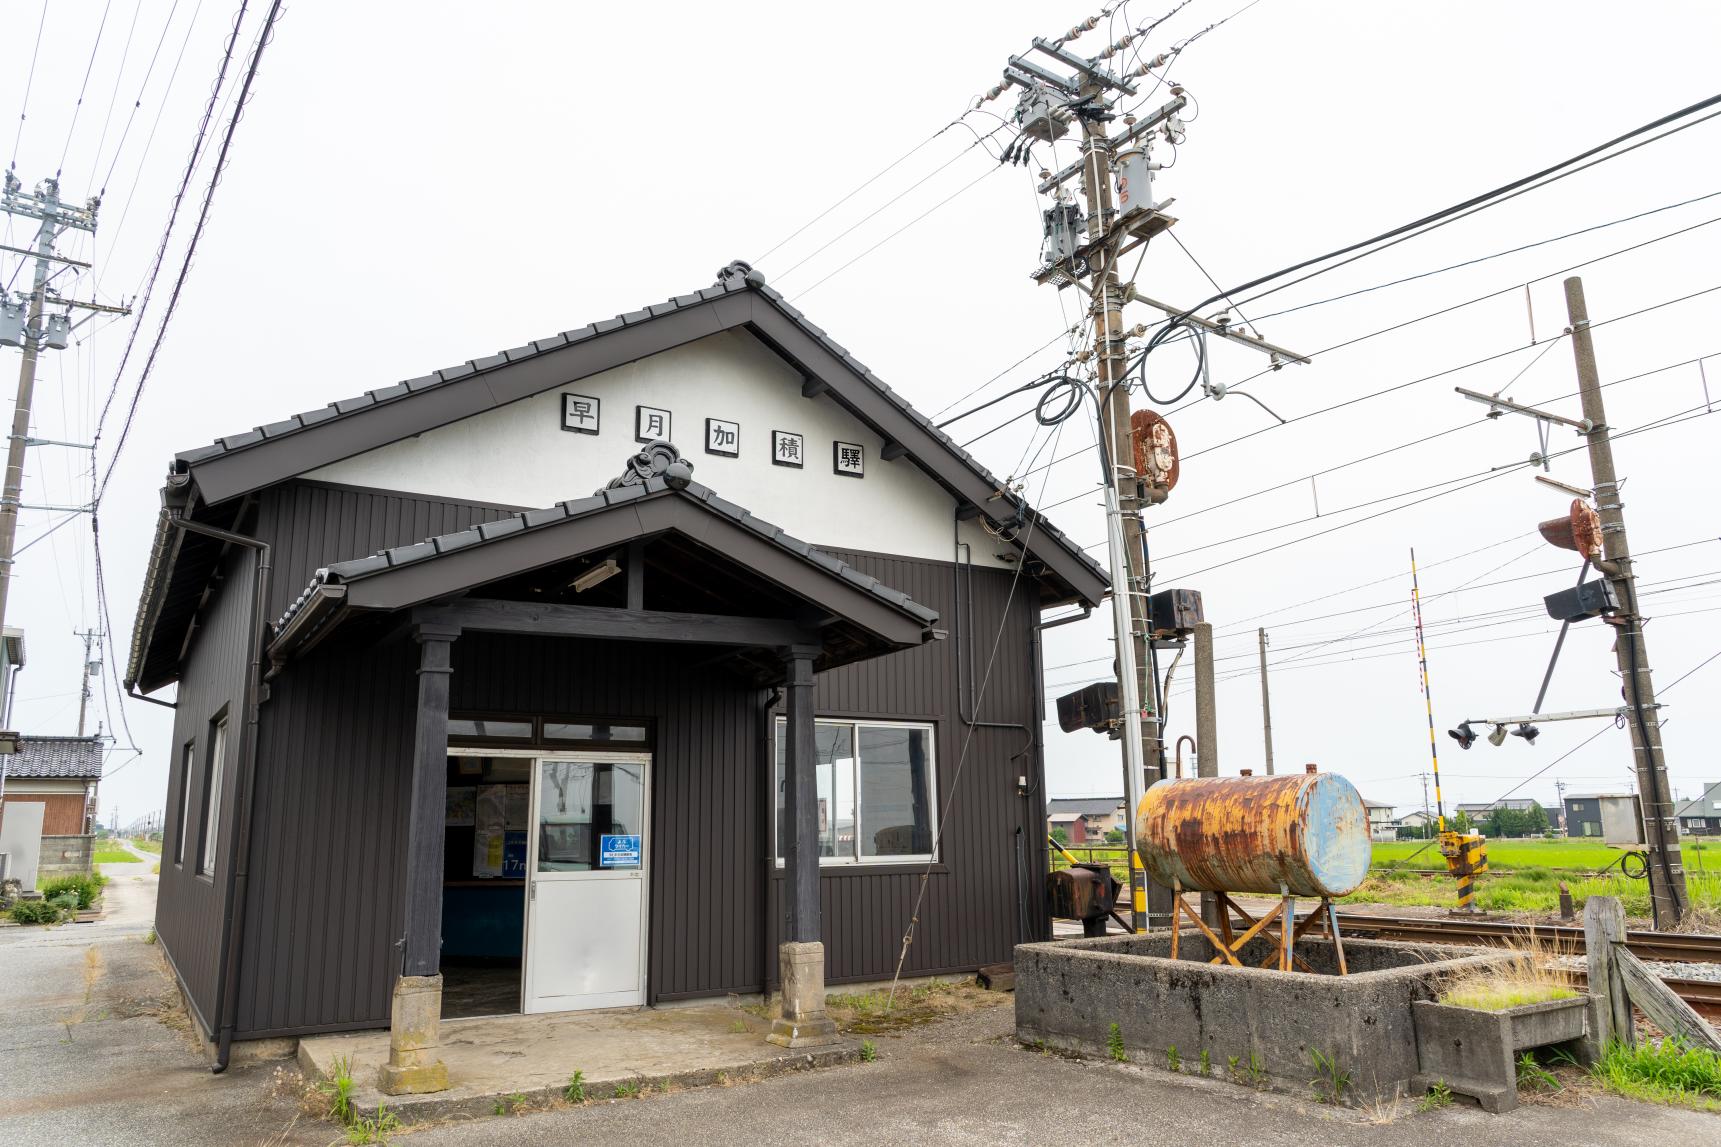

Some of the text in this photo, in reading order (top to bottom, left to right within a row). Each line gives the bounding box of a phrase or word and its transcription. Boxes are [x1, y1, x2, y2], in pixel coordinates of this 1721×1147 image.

[568, 400, 861, 469] 早月加積驛
